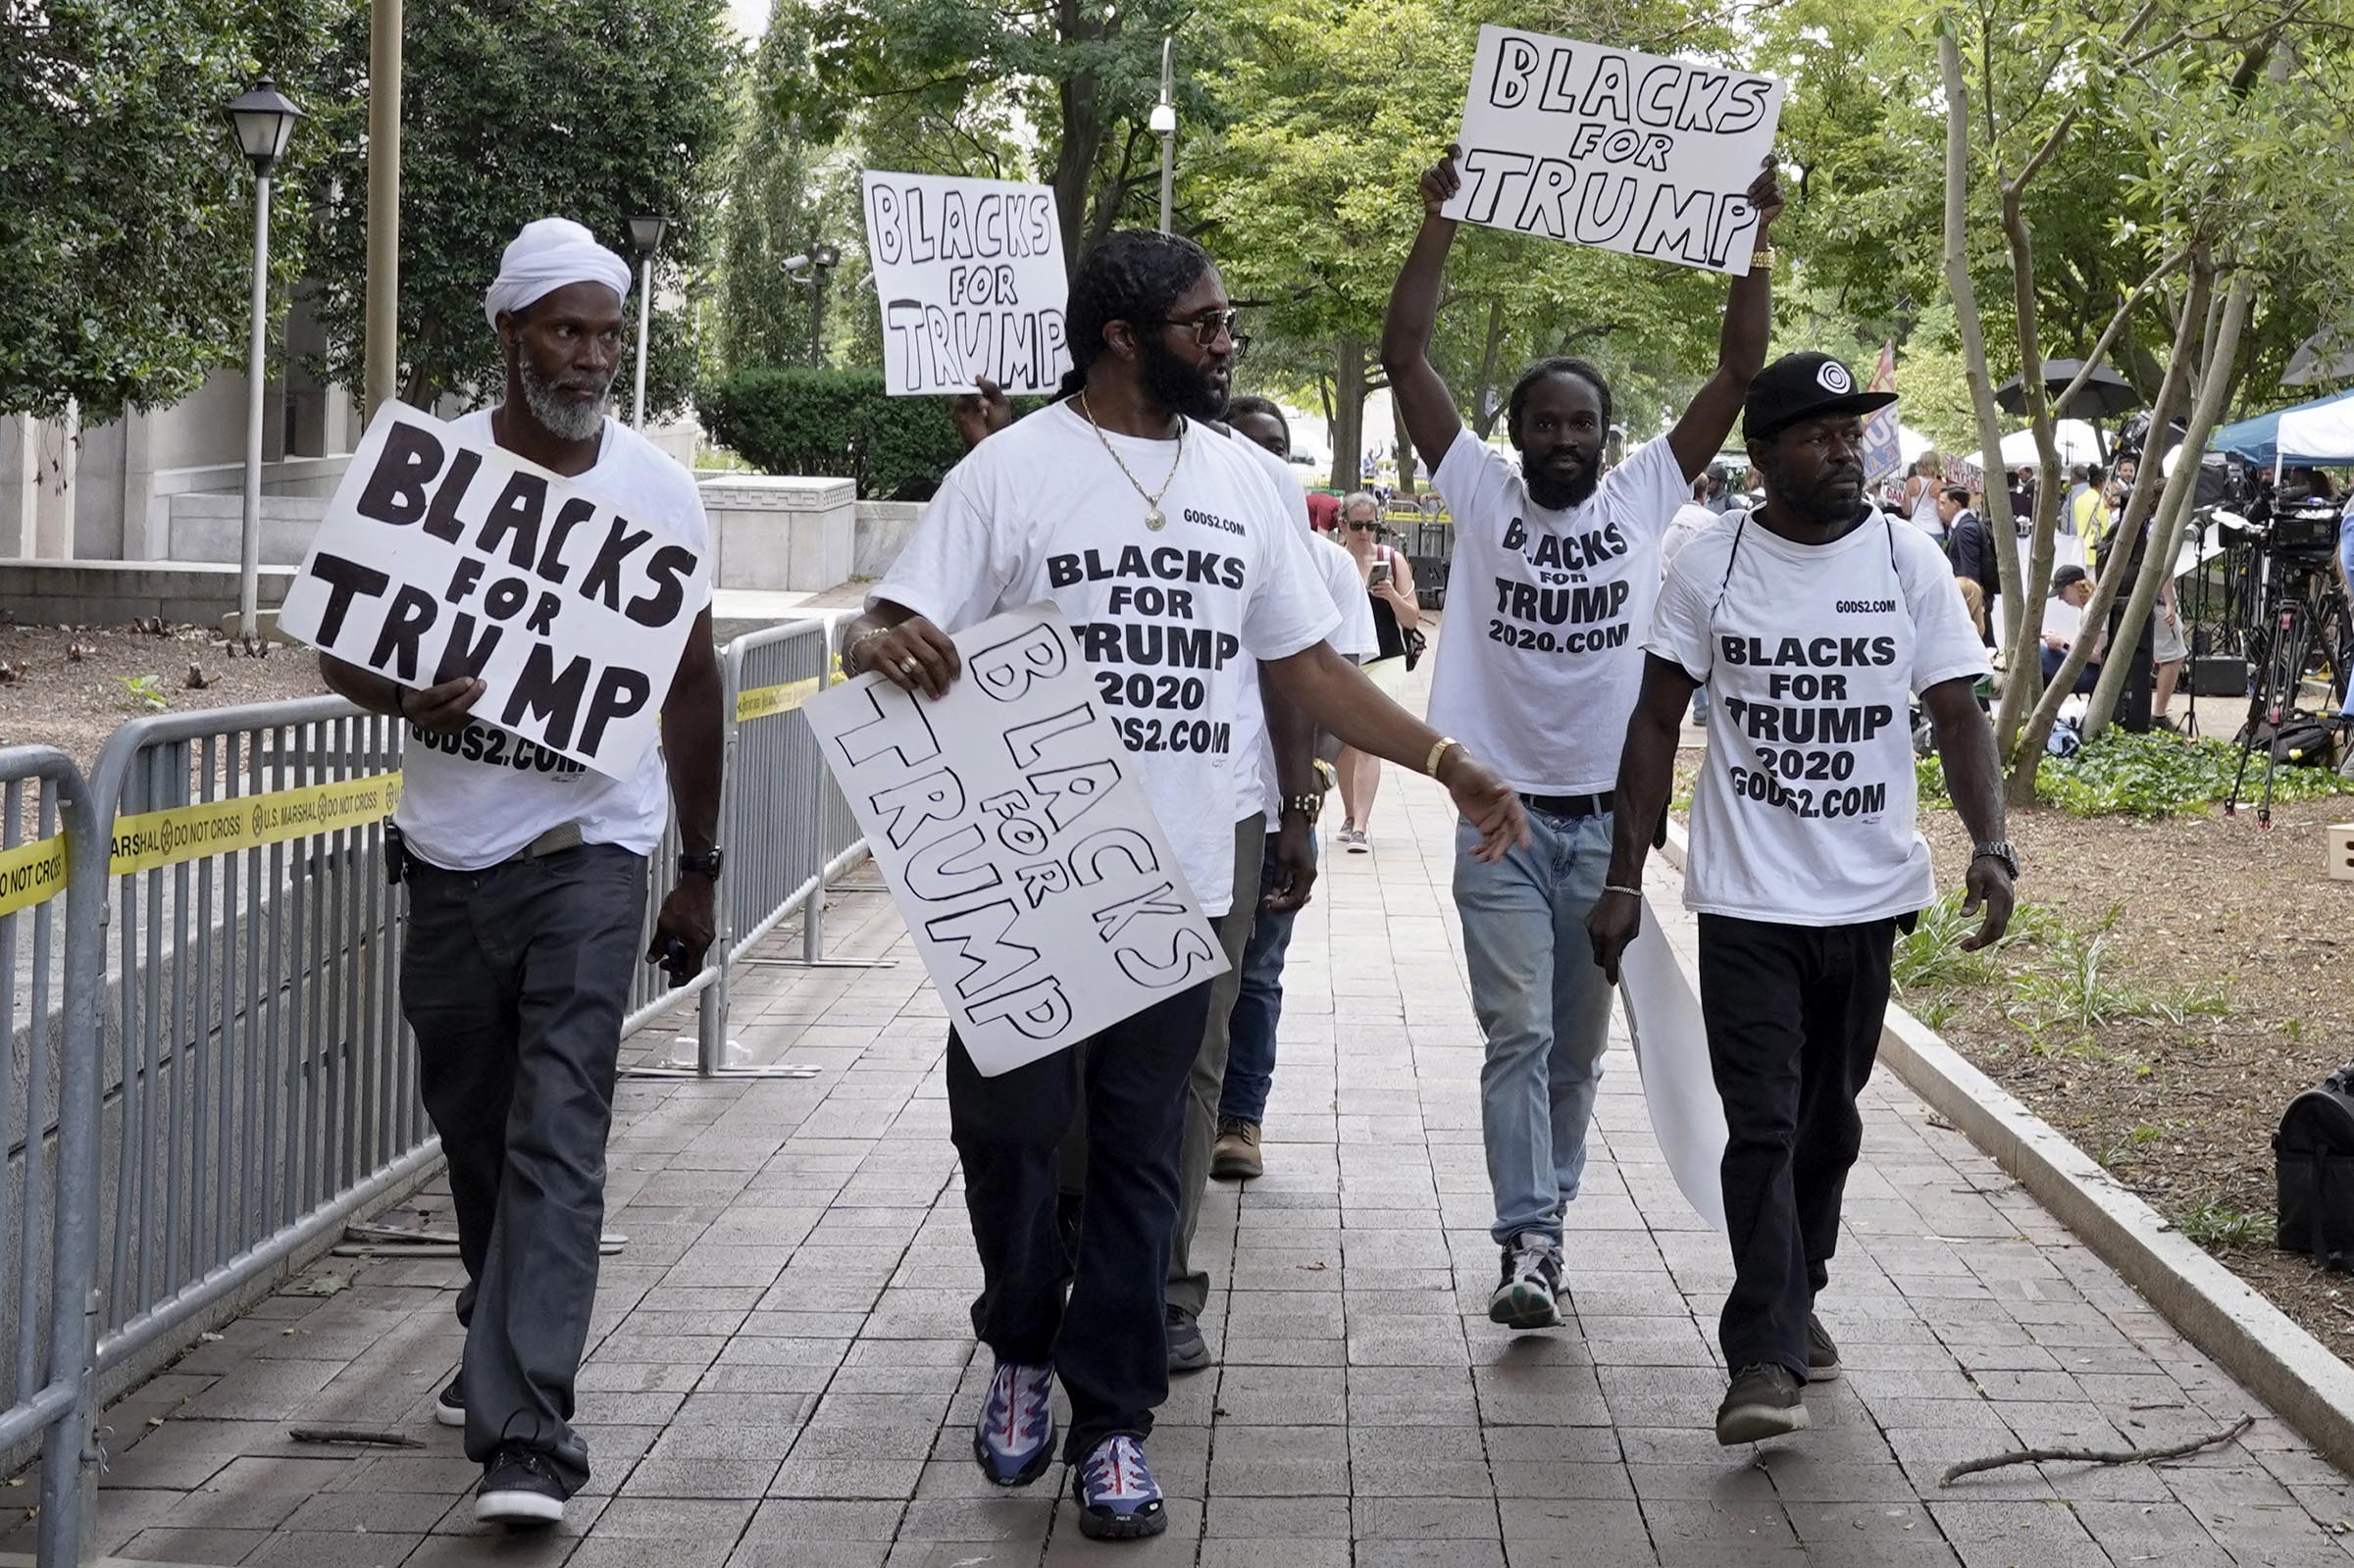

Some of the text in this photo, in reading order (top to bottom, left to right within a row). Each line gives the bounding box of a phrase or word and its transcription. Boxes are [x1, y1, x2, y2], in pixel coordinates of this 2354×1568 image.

[1490, 37, 1772, 133] BLACKS
[1569, 124, 1673, 172] FOR
[872, 184, 1050, 265] BLACKS
[1465, 149, 1758, 267] TRUMP
[950, 265, 1018, 306] FOR
[888, 299, 1067, 391] TRUMP
[357, 421, 696, 627] BLACKS
[1184, 508, 1246, 536] GODS2.COM
[1047, 545, 1246, 589] BLACKS
[445, 557, 561, 635] FOR
[1108, 586, 1193, 619] FOR
[1495, 577, 1629, 625] TRUMP
[1836, 600, 1896, 613] GODS2.COM
[311, 553, 649, 757] TRUMP
[1489, 619, 1629, 653] 2020.COM
[1721, 635, 1896, 667] BLACKS
[1095, 671, 1204, 710] 2020
[1769, 674, 1847, 701] FOR
[1724, 696, 1893, 744] TRUMP
[1755, 747, 1855, 782] 2020
[969, 622, 1213, 988] BLACKS
[1729, 766, 1886, 819] GODS2.COM
[110, 833, 160, 859] ARSHAL
[174, 824, 188, 846] DO
[189, 821, 210, 844] NOT
[210, 815, 241, 839] CROSS
[263, 806, 279, 829] U.S.
[281, 801, 317, 826] MARSHAL
[327, 797, 338, 817] DO
[338, 794, 354, 815] NOT
[354, 791, 378, 812] CROSS
[980, 789, 1069, 909] FOR
[0, 872, 8, 897] O
[10, 864, 33, 894] NOT
[835, 681, 1072, 1039] TRUMP
